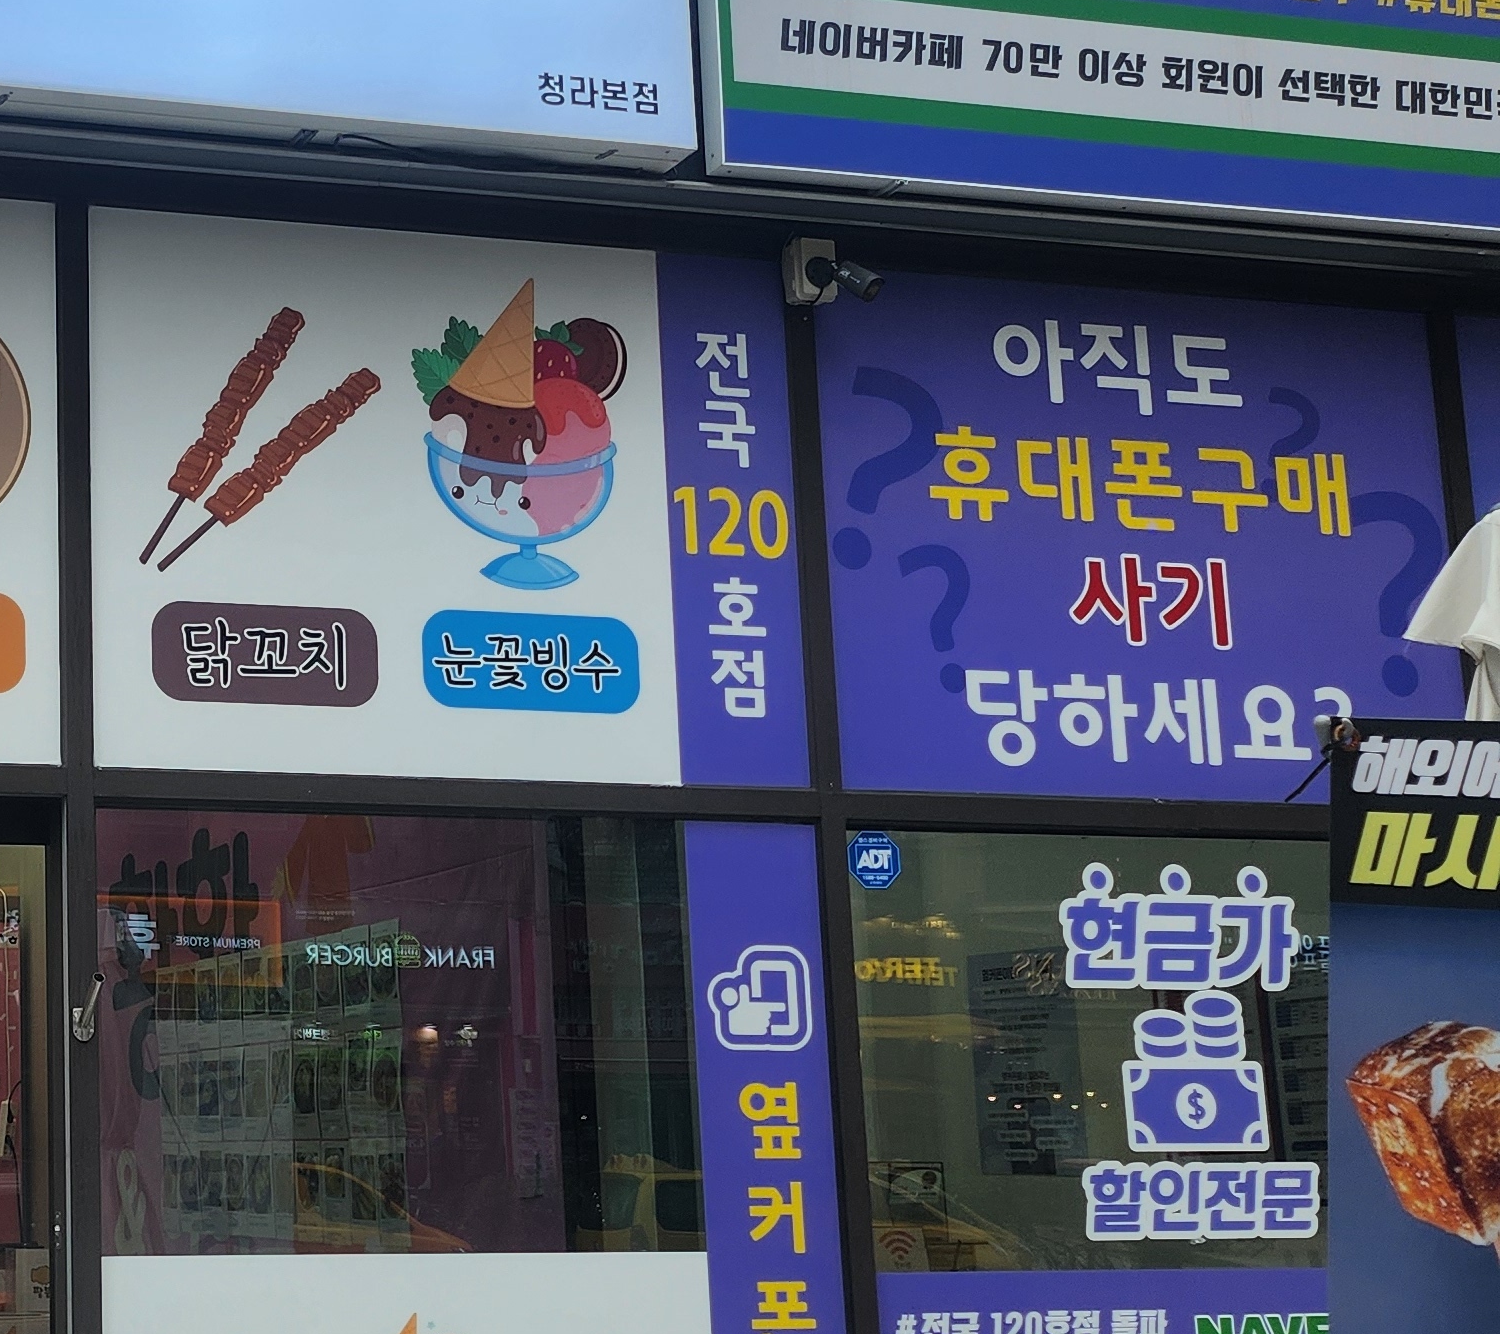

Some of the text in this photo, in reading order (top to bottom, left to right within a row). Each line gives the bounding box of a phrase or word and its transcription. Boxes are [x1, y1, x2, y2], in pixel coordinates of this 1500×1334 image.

[537, 72, 661, 116] 청라본점
[780, 17, 1500, 120] 네이버카페 70만 이상 회원이 선택한 대한민
[992, 318, 1244, 416] 아직도
[929, 425, 1352, 537] 휴대폰구매
[672, 487, 790, 560] 120
[1068, 552, 1233, 651] 사기
[182, 619, 349, 692] 닭꼬치
[432, 632, 623, 693] 눈꽃빙수
[857, 848, 892, 870] ADT
[1058, 875, 1299, 993] 현금가
[1082, 1159, 1321, 1242] 할인전문
